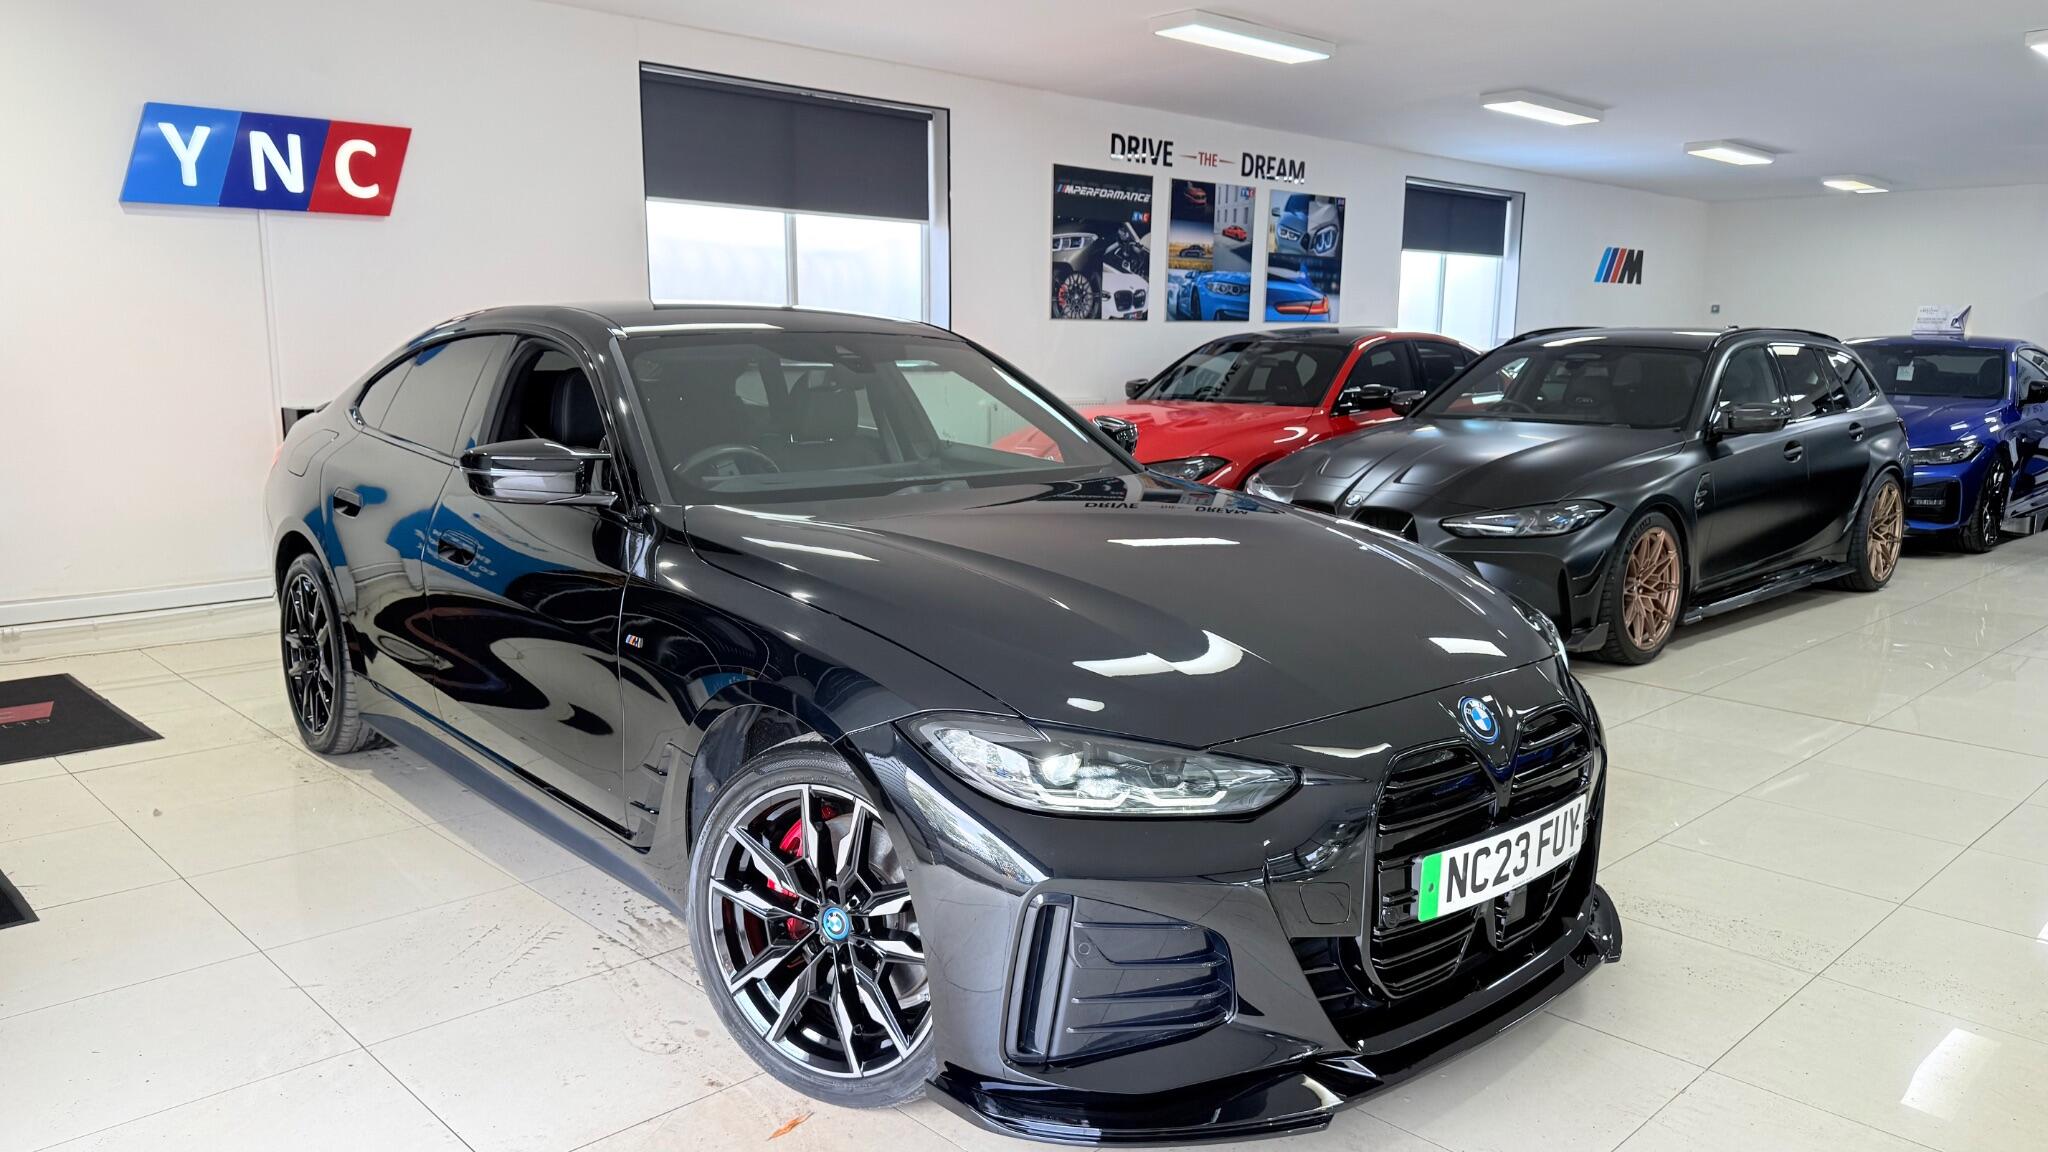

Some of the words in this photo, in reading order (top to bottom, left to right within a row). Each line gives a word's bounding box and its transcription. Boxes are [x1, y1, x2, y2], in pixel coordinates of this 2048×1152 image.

[157, 122, 380, 199] YNC
[1110, 133, 1174, 167] DRIVE
[1198, 152, 1218, 167] THE
[1241, 152, 1305, 184] DREAM
[1446, 831, 1530, 903] NC23
[1536, 803, 1581, 867] FUY
